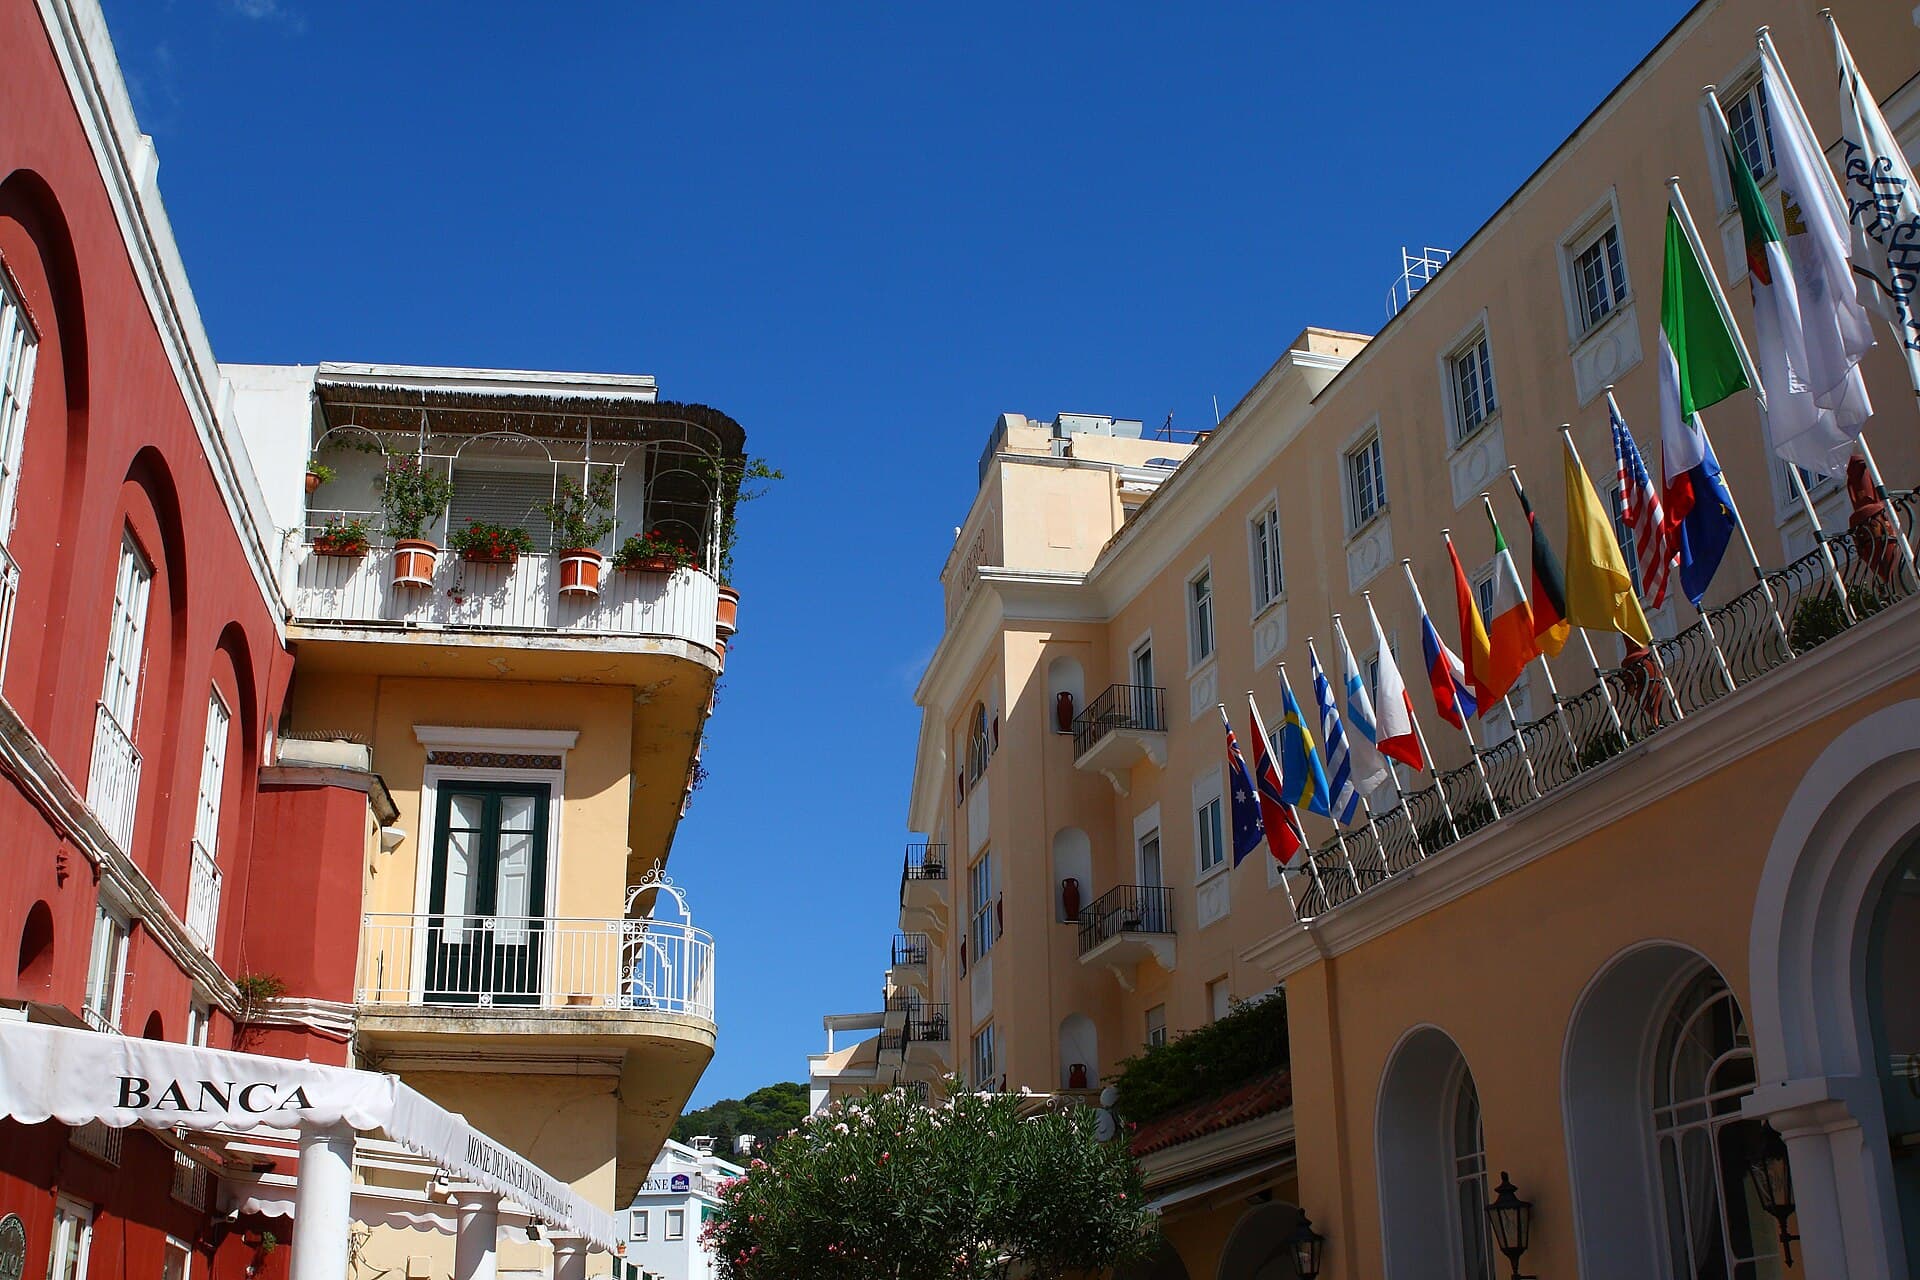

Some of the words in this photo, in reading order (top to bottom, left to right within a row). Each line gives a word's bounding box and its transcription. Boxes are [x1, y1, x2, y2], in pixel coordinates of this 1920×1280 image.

[114, 1075, 315, 1113] BANCA
[464, 1134, 491, 1173] MONTE
[491, 1149, 504, 1180] DEI
